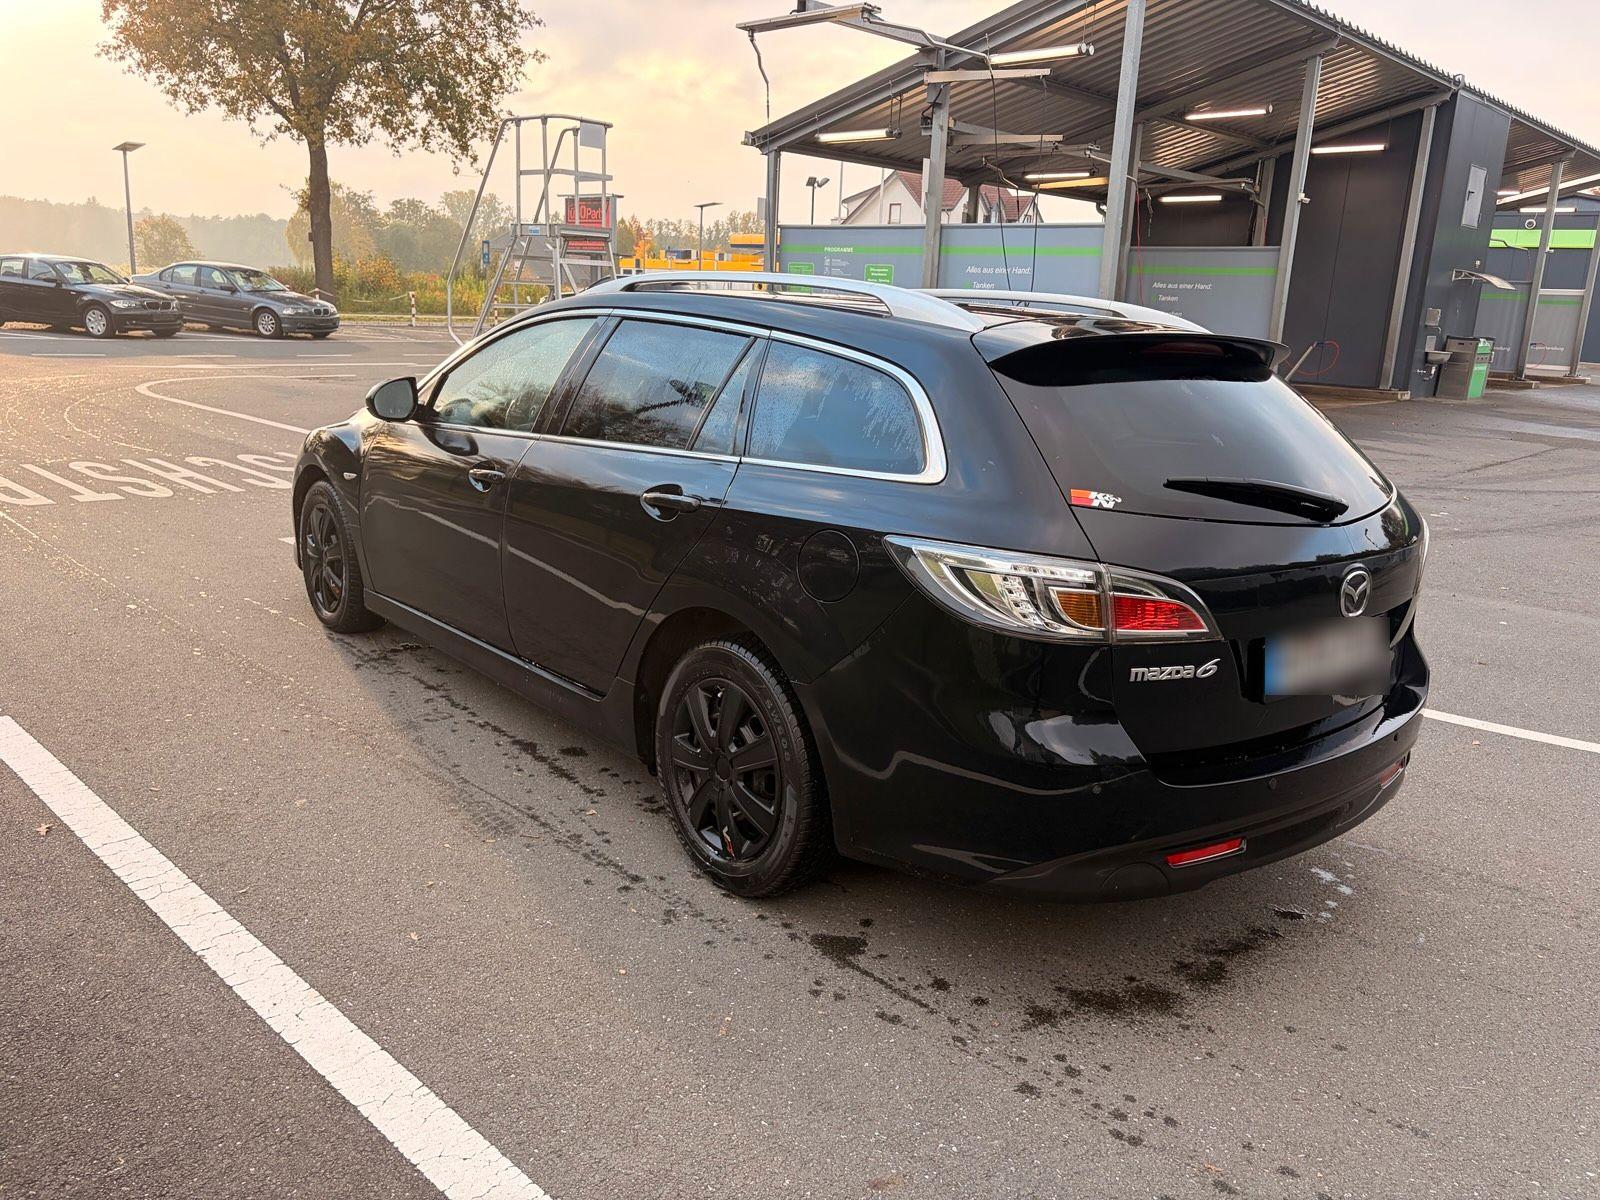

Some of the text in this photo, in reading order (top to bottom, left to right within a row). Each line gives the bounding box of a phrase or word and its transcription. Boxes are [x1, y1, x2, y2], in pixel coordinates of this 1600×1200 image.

[966, 265, 981, 274] Alles
[995, 266, 1011, 274] einer
[1012, 266, 1032, 275] Hand:
[973, 281, 995, 289] Tanken
[1152, 281, 1167, 289] Alles
[1158, 294, 1179, 302] Tanken
